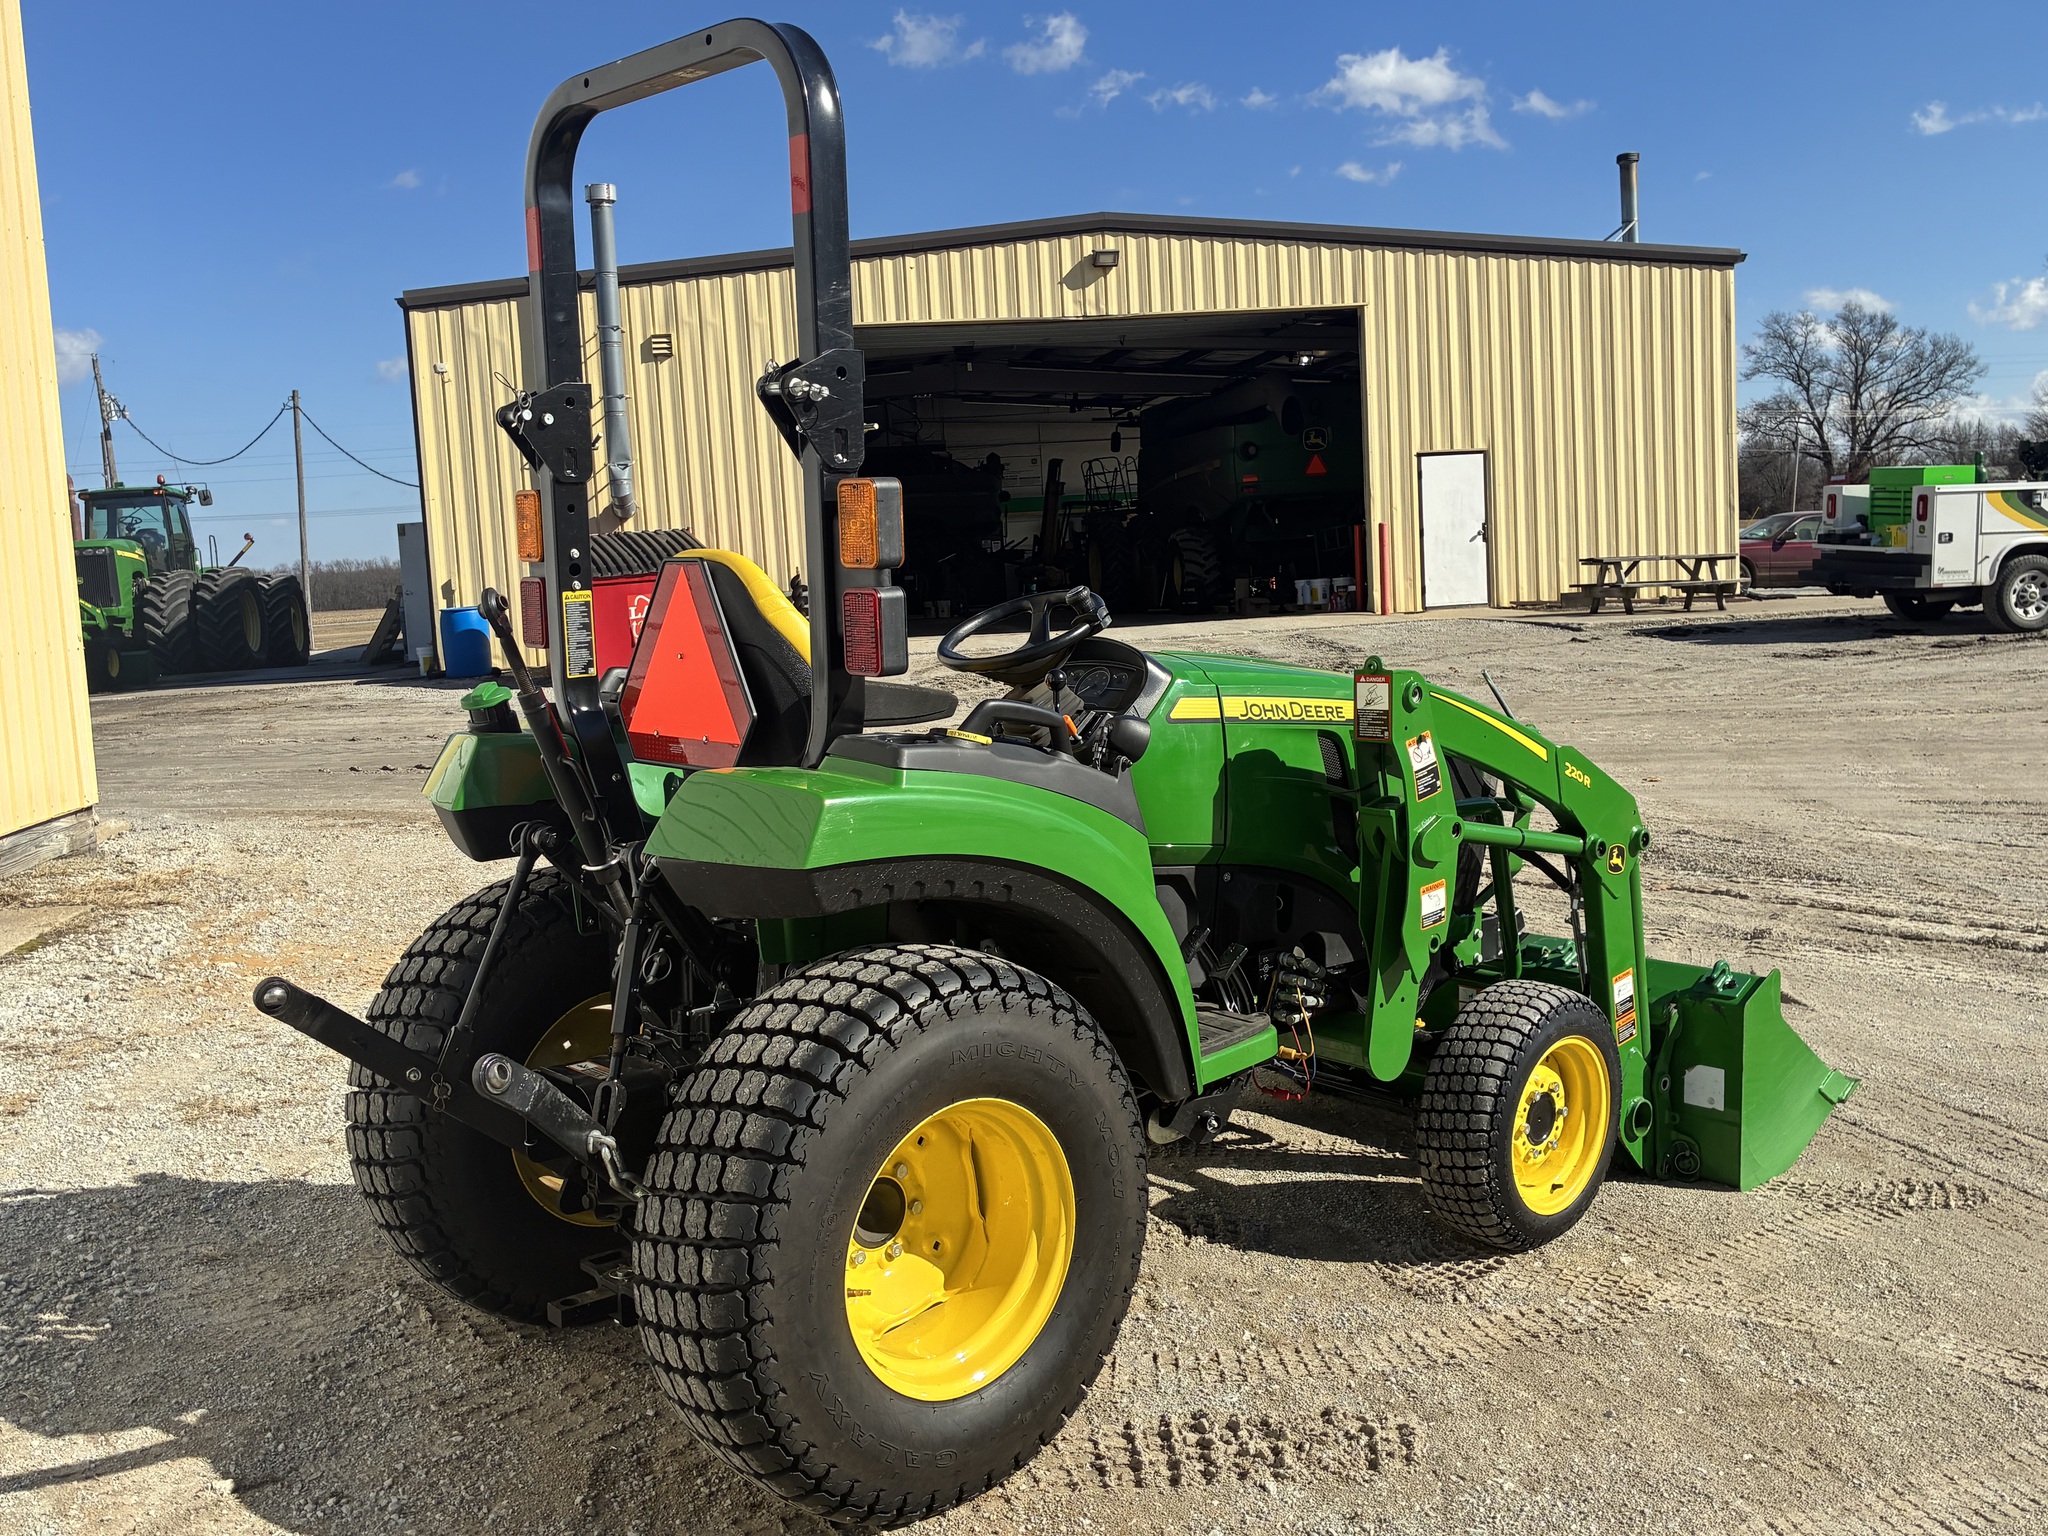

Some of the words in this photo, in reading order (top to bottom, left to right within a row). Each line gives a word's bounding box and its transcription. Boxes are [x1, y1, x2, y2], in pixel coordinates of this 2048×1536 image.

[1240, 701, 1288, 718] JOHN
[1289, 702, 1346, 719] DEERE
[951, 1041, 1085, 1090] MIGHTY
[1095, 1110, 1124, 1199] MOW
[809, 1372, 958, 1468] GALAXY
